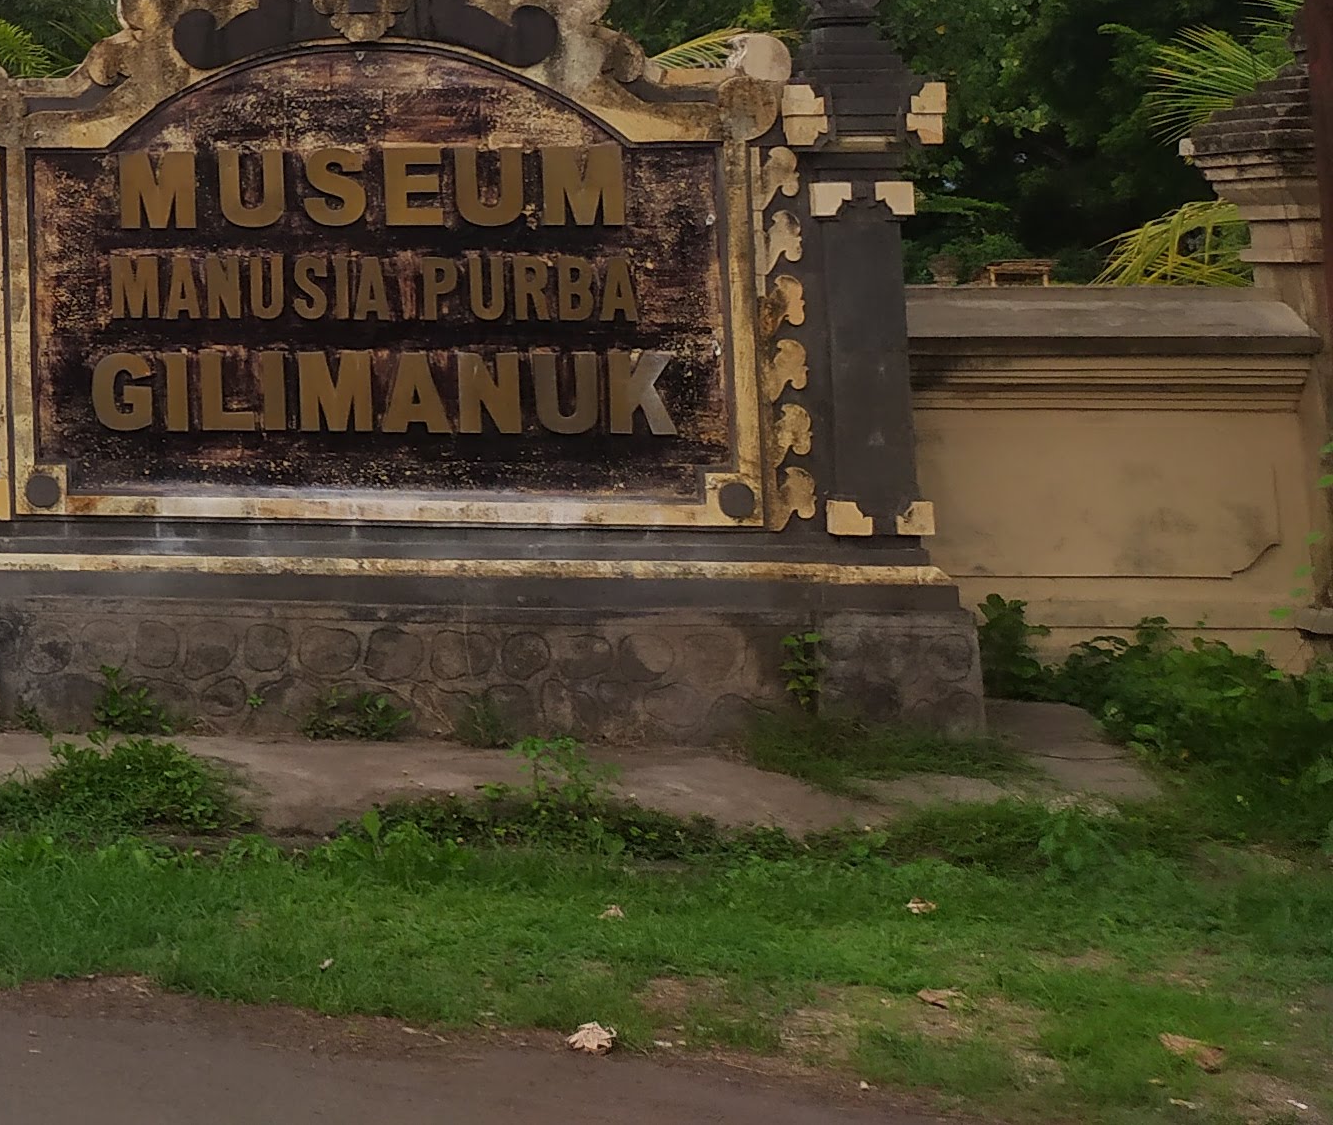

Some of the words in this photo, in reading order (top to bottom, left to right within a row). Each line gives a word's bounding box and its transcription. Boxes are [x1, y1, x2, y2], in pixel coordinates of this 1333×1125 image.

[118, 144, 626, 229] MUSEUM
[110, 255, 391, 321] MANUSIA
[420, 255, 637, 322] PURBA
[90, 350, 677, 436] GILIMANUK
